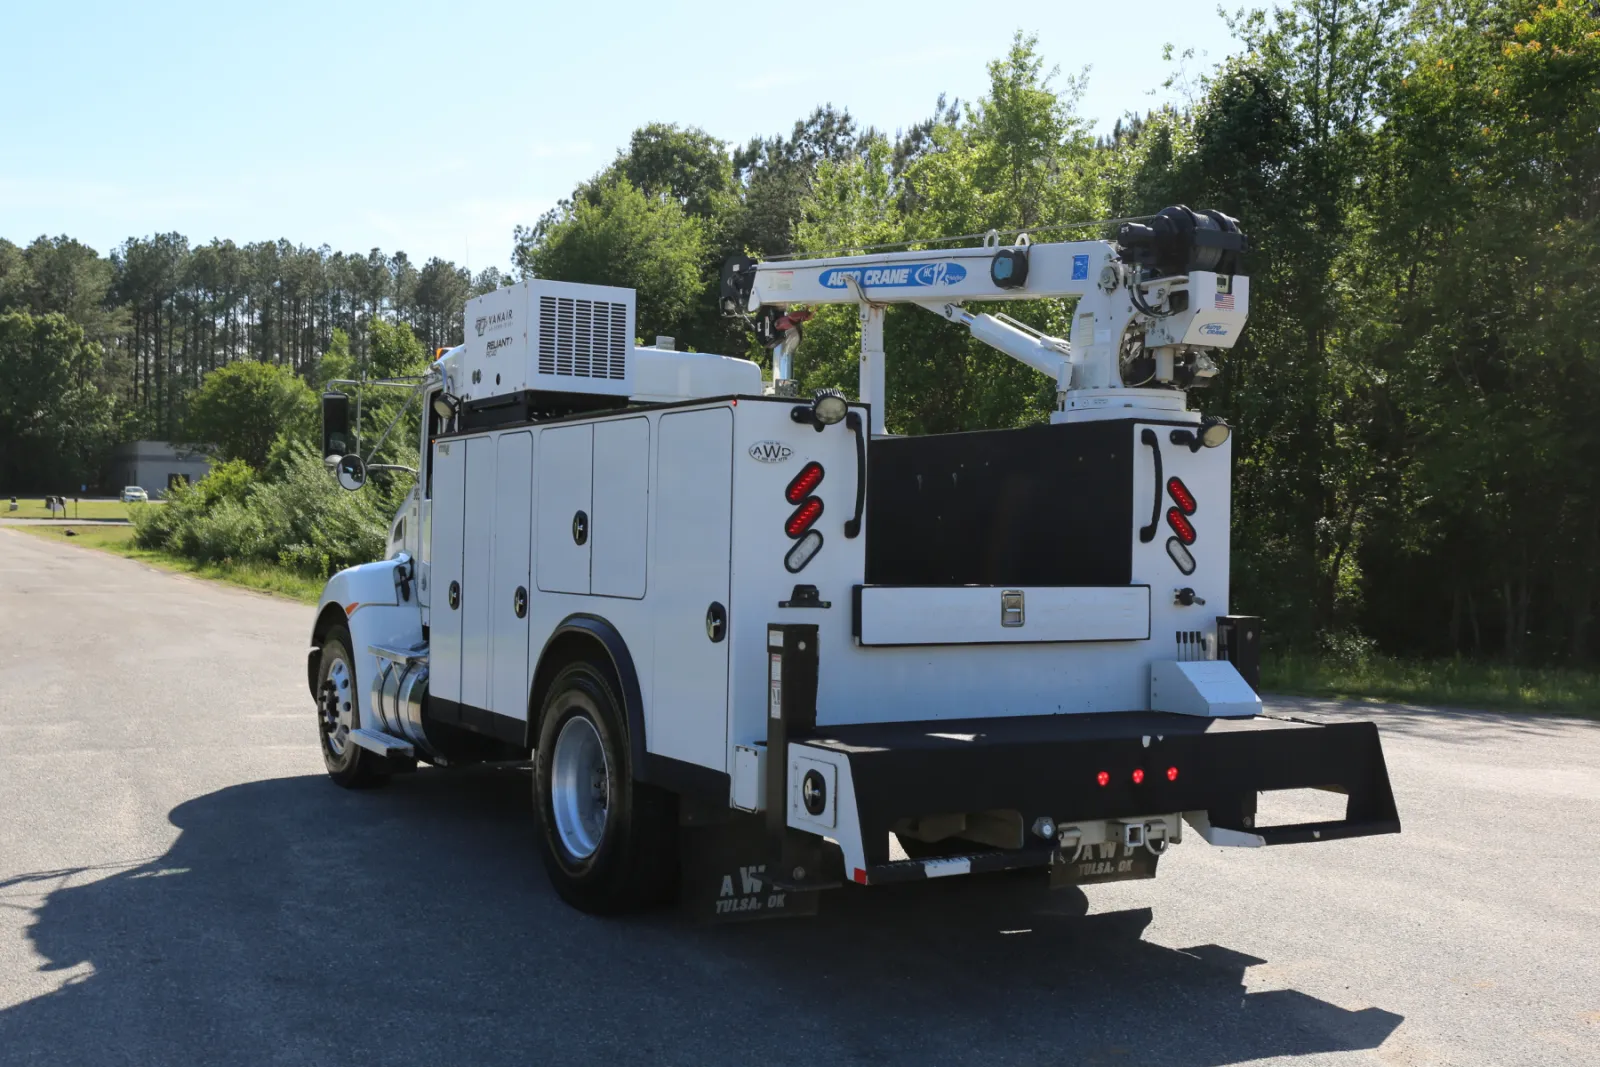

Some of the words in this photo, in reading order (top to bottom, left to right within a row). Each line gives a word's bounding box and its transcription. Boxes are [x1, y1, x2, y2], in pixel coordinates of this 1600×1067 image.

[864, 268, 909, 285] CRANE
[923, 267, 933, 278] HC
[488, 309, 513, 325] VANAIR
[486, 337, 510, 351] RELIANT
[753, 445, 791, 458] AWD
[1079, 862, 1115, 876] TULSA,
[1118, 860, 1133, 872] OK
[715, 896, 763, 914] TULSA,
[767, 892, 787, 908] OK
